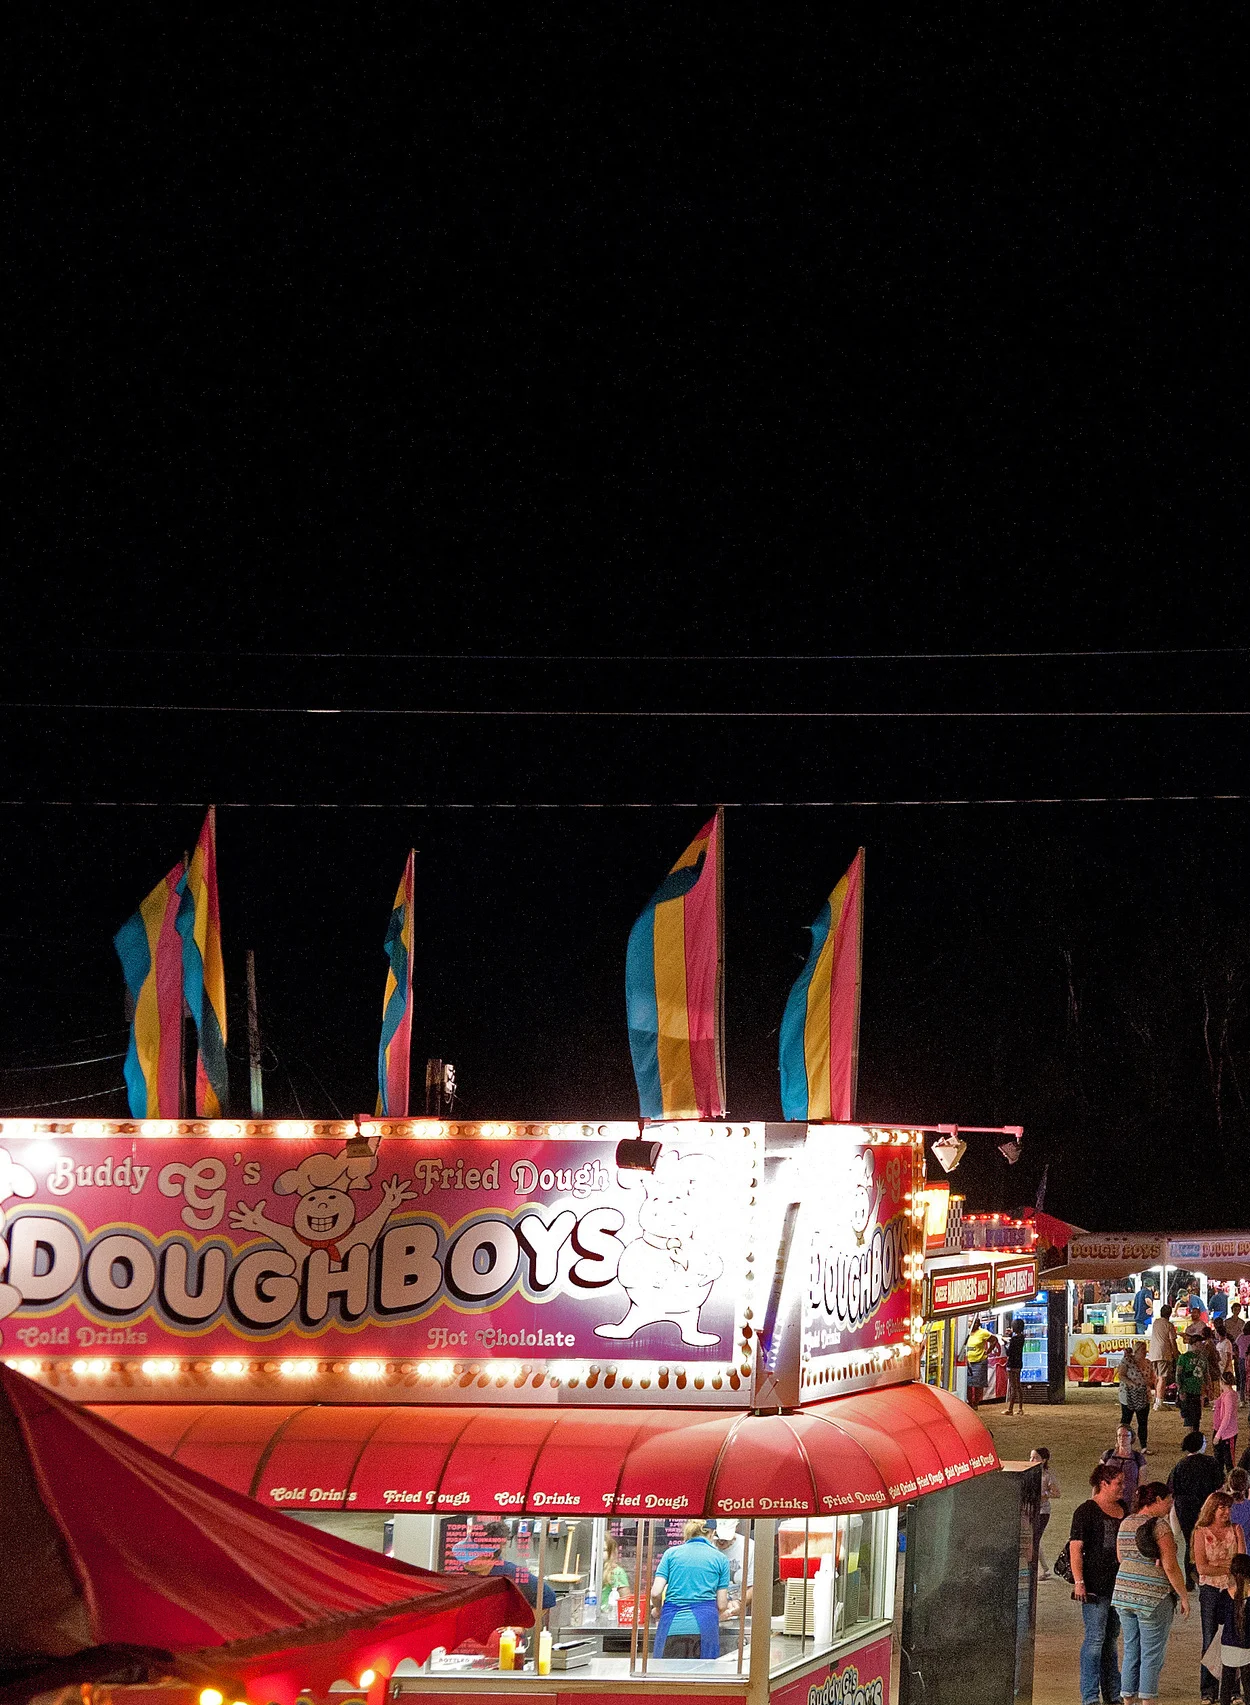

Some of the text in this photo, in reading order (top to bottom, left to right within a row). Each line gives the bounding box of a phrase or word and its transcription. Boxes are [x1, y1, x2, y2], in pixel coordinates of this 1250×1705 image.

[414, 1159, 611, 1198] Fried Dough
[47, 1153, 261, 1230] Buddy G's
[1071, 1242, 1120, 1259] DOUGH
[1121, 1242, 1161, 1259] BOYS
[1202, 1241, 1237, 1257] DOUGH
[8, 1206, 626, 1327] DOUGHBOYS
[16, 1326, 148, 1347] Cold Drinks
[427, 1328, 576, 1350] Hot Chololate
[1099, 1337, 1131, 1354] DOUGH
[928, 1470, 944, 1485] Dough
[269, 1487, 307, 1502] Cold
[900, 1480, 918, 1496] Drinks
[383, 1490, 422, 1504] Fried
[533, 1492, 581, 1506] Drinks
[602, 1493, 689, 1510] Fried Dough
[718, 1497, 809, 1512] Cold Drinks
[822, 1490, 887, 1509] Fried Dough
[809, 1675, 842, 1705] Buddy
